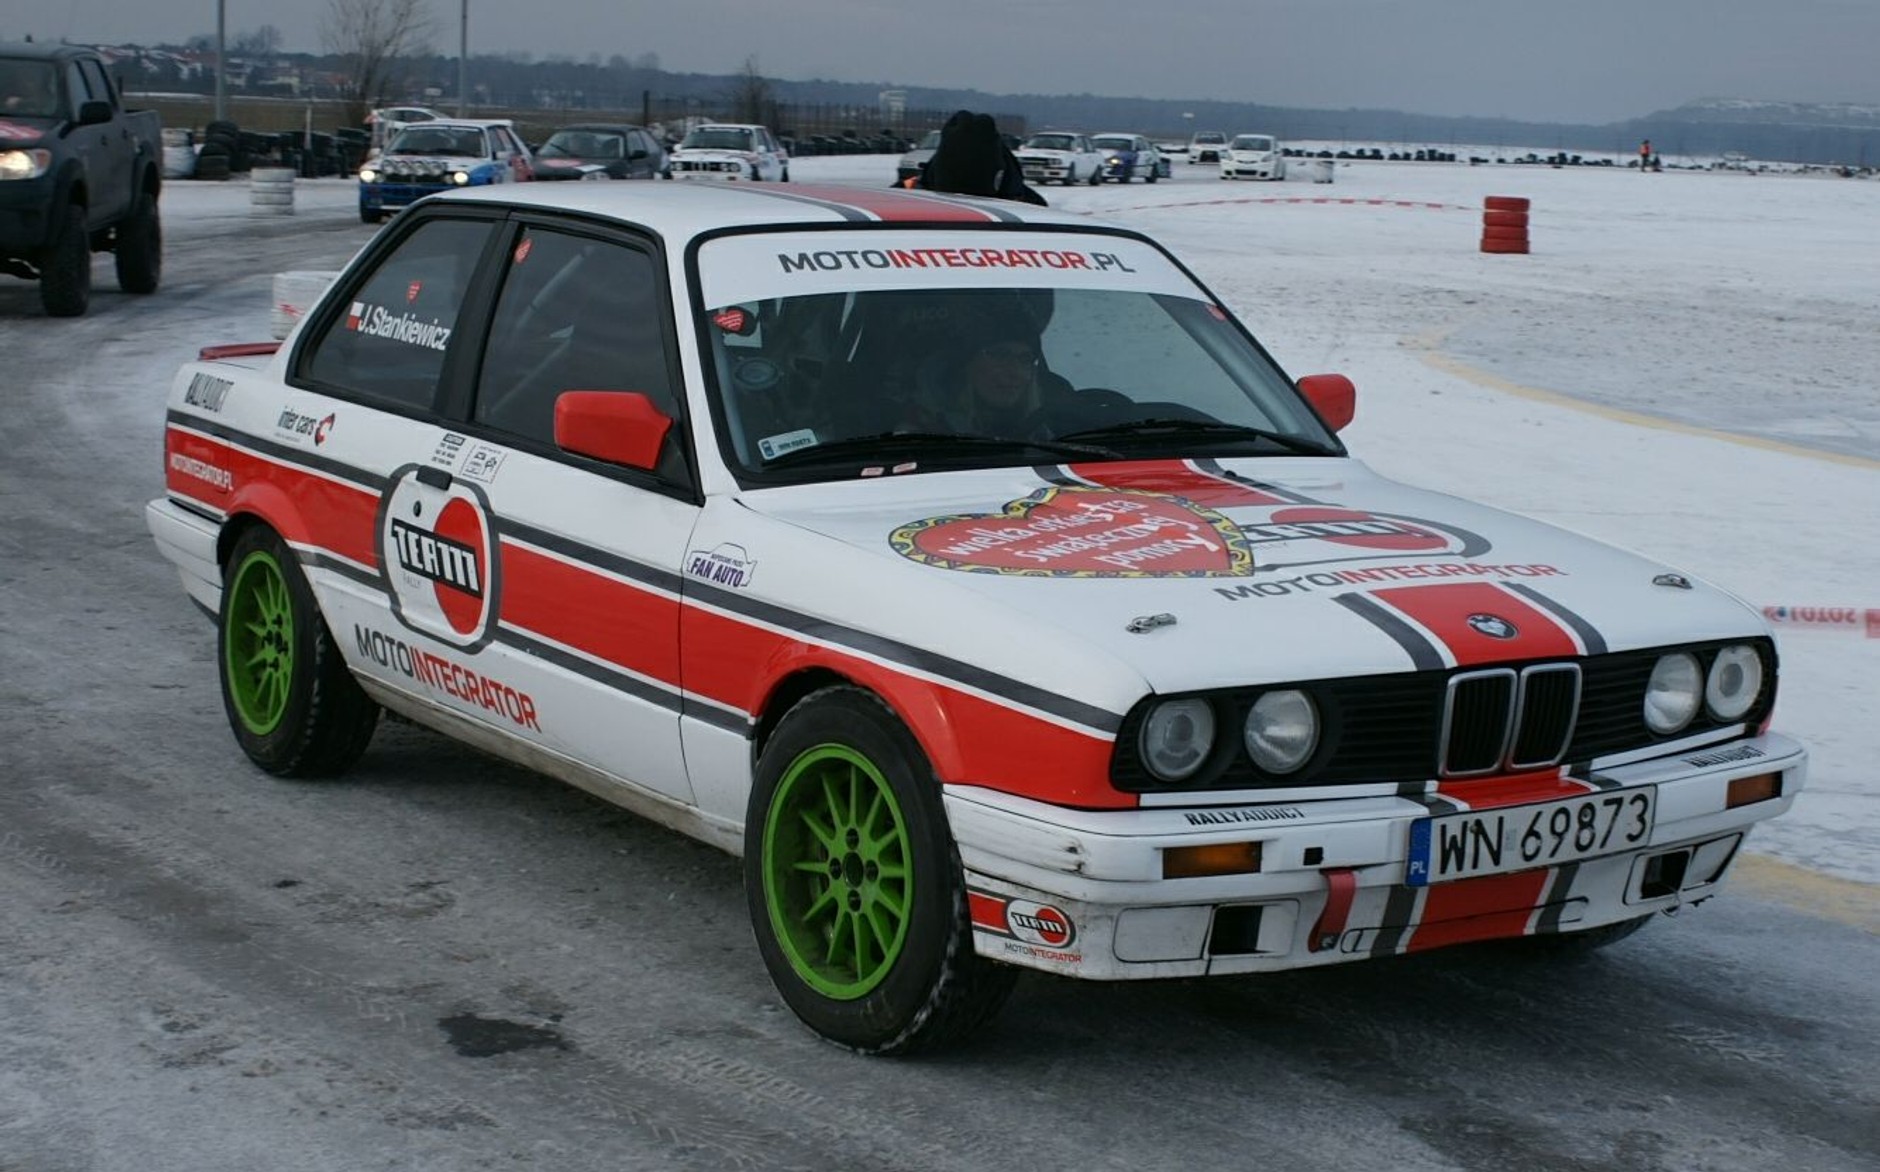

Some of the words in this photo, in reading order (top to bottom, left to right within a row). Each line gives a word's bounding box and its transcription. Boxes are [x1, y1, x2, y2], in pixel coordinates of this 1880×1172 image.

[778, 249, 1136, 273] MOTOINTEGRATOR.PL
[357, 305, 450, 350] J.Stankiewicz
[278, 405, 299, 430] inter
[295, 414, 317, 436] cars
[939, 521, 1034, 557] wielka
[1092, 532, 1220, 570] pomocy
[690, 557, 715, 579] FAN
[711, 564, 744, 588] AUTO
[1213, 562, 1568, 601] MOTOINTEGRATOR
[355, 623, 542, 734] MOTOINTEGRATOR
[1184, 807, 1305, 826] RALLYADDICT
[1439, 814, 1505, 875] WN
[1520, 793, 1649, 862] 69873
[1409, 860, 1427, 875] PL
[1004, 942, 1083, 963] MOTOINTEGRATOR
